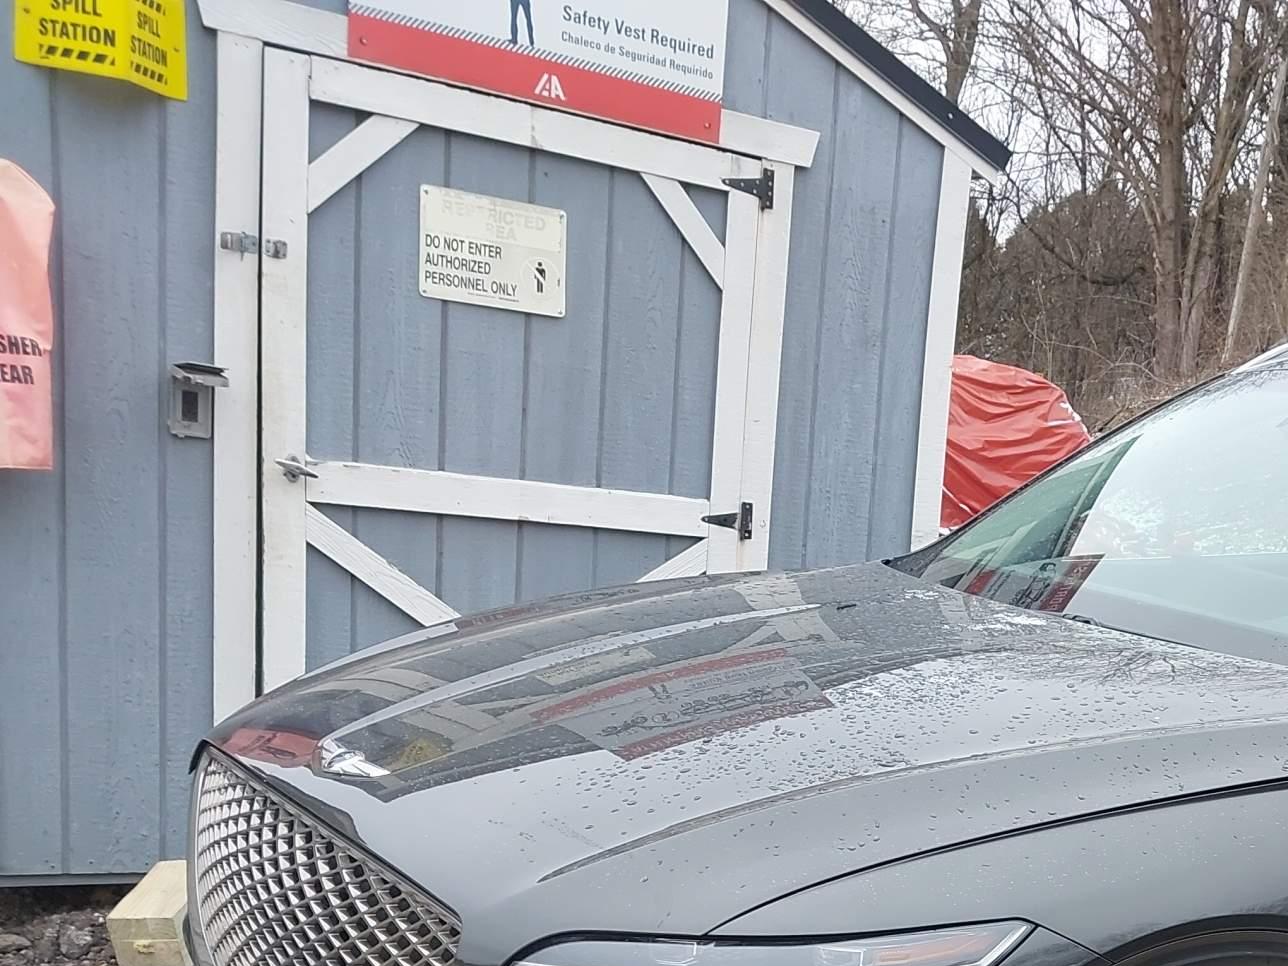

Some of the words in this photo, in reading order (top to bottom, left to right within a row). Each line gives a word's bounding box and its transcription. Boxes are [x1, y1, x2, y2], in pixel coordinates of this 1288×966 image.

[39, 17, 116, 48] STATION
[136, 10, 161, 38] SPILL
[562, 4, 610, 36] Safety
[614, 18, 647, 42] Vest
[651, 28, 714, 59] Required
[130, 35, 168, 68] STATION
[561, 31, 601, 51] Chaleco
[604, 42, 616, 54] de
[618, 46, 667, 68] Seguridad
[669, 59, 714, 80] Requirido
[424, 234, 441, 249] DO
[443, 237, 465, 252] NOT
[468, 241, 502, 259] ENTER
[424, 252, 492, 275] AUTHORIZED
[424, 270, 488, 293] PERSONNEL
[491, 281, 518, 297] ONLY
